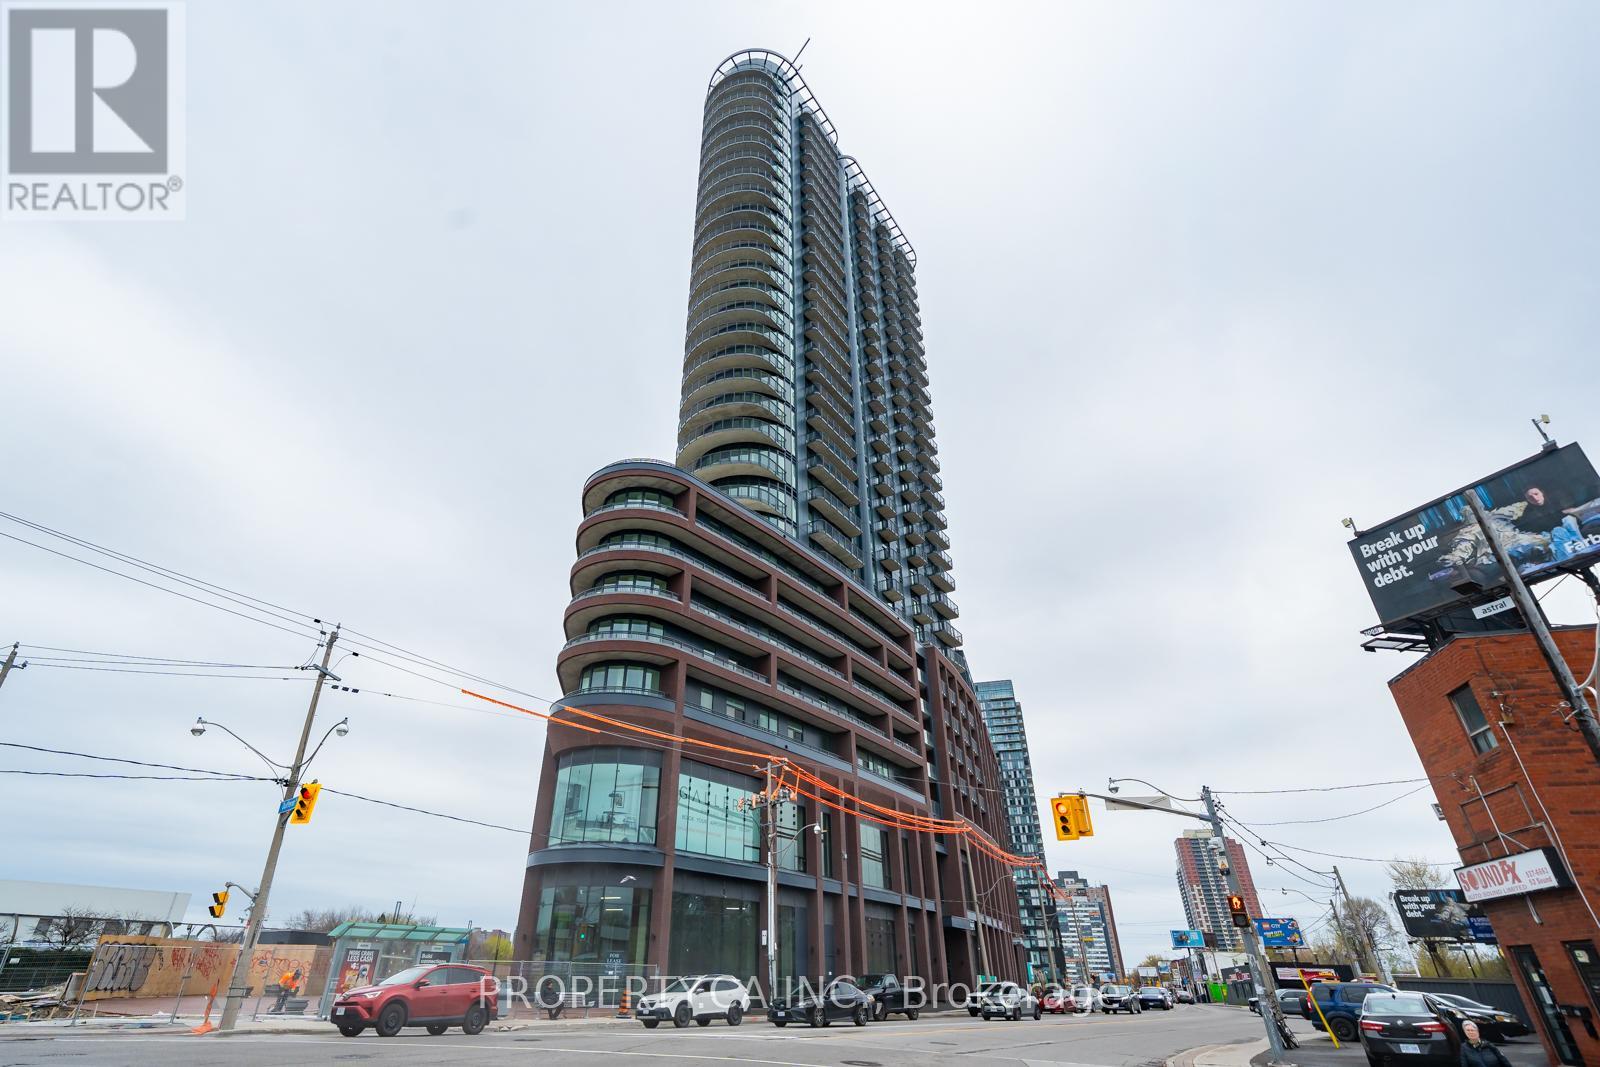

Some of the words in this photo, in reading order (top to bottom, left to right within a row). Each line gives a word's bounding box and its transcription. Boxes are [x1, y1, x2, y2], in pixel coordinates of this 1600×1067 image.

[1360, 531, 1404, 558] Break
[1403, 524, 1426, 540] up
[1366, 549, 1402, 573] with
[1402, 535, 1439, 563] your
[1374, 565, 1414, 588] debt.
[1481, 601, 1507, 615] astral
[1503, 884, 1528, 894] LIMITED
[1400, 895, 1420, 903] Break
[1403, 902, 1419, 910] with
[1420, 903, 1436, 911] your
